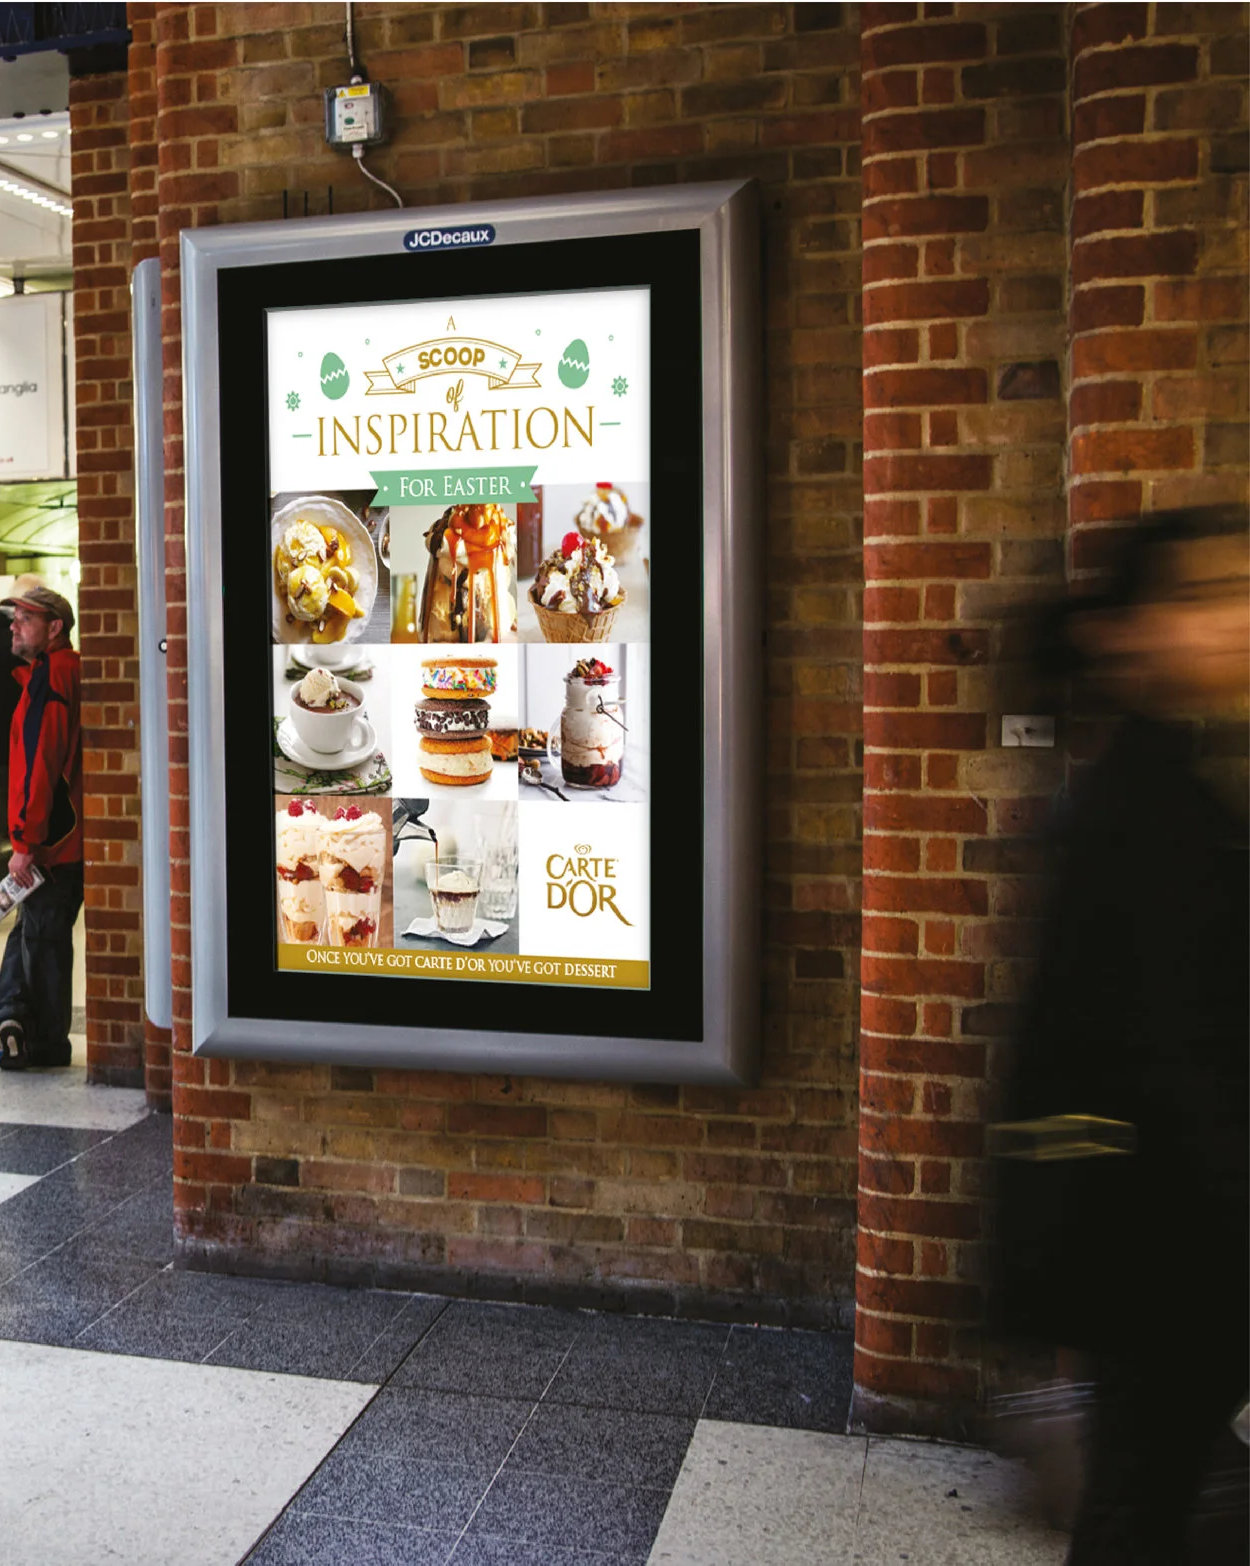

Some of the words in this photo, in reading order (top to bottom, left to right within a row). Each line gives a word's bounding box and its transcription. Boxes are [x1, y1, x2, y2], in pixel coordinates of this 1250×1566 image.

[409, 230, 489, 248] JCDecaux
[446, 315, 456, 331] A
[417, 346, 486, 370] SCOOP
[445, 378, 464, 412] of
[317, 405, 595, 457] INSPIRATION
[399, 476, 436, 498] FOR
[443, 474, 513, 497] EASTER
[546, 853, 617, 882] CARTE
[546, 878, 636, 927] D'OR
[306, 949, 341, 965] ONCE
[343, 951, 384, 967] YOU'VE
[386, 954, 412, 968] GOT
[414, 955, 453, 971] CARTE
[456, 956, 486, 972] D'OR
[488, 958, 531, 974] YOU'VE
[533, 961, 561, 976] GOT
[564, 963, 617, 979] DESSERT
